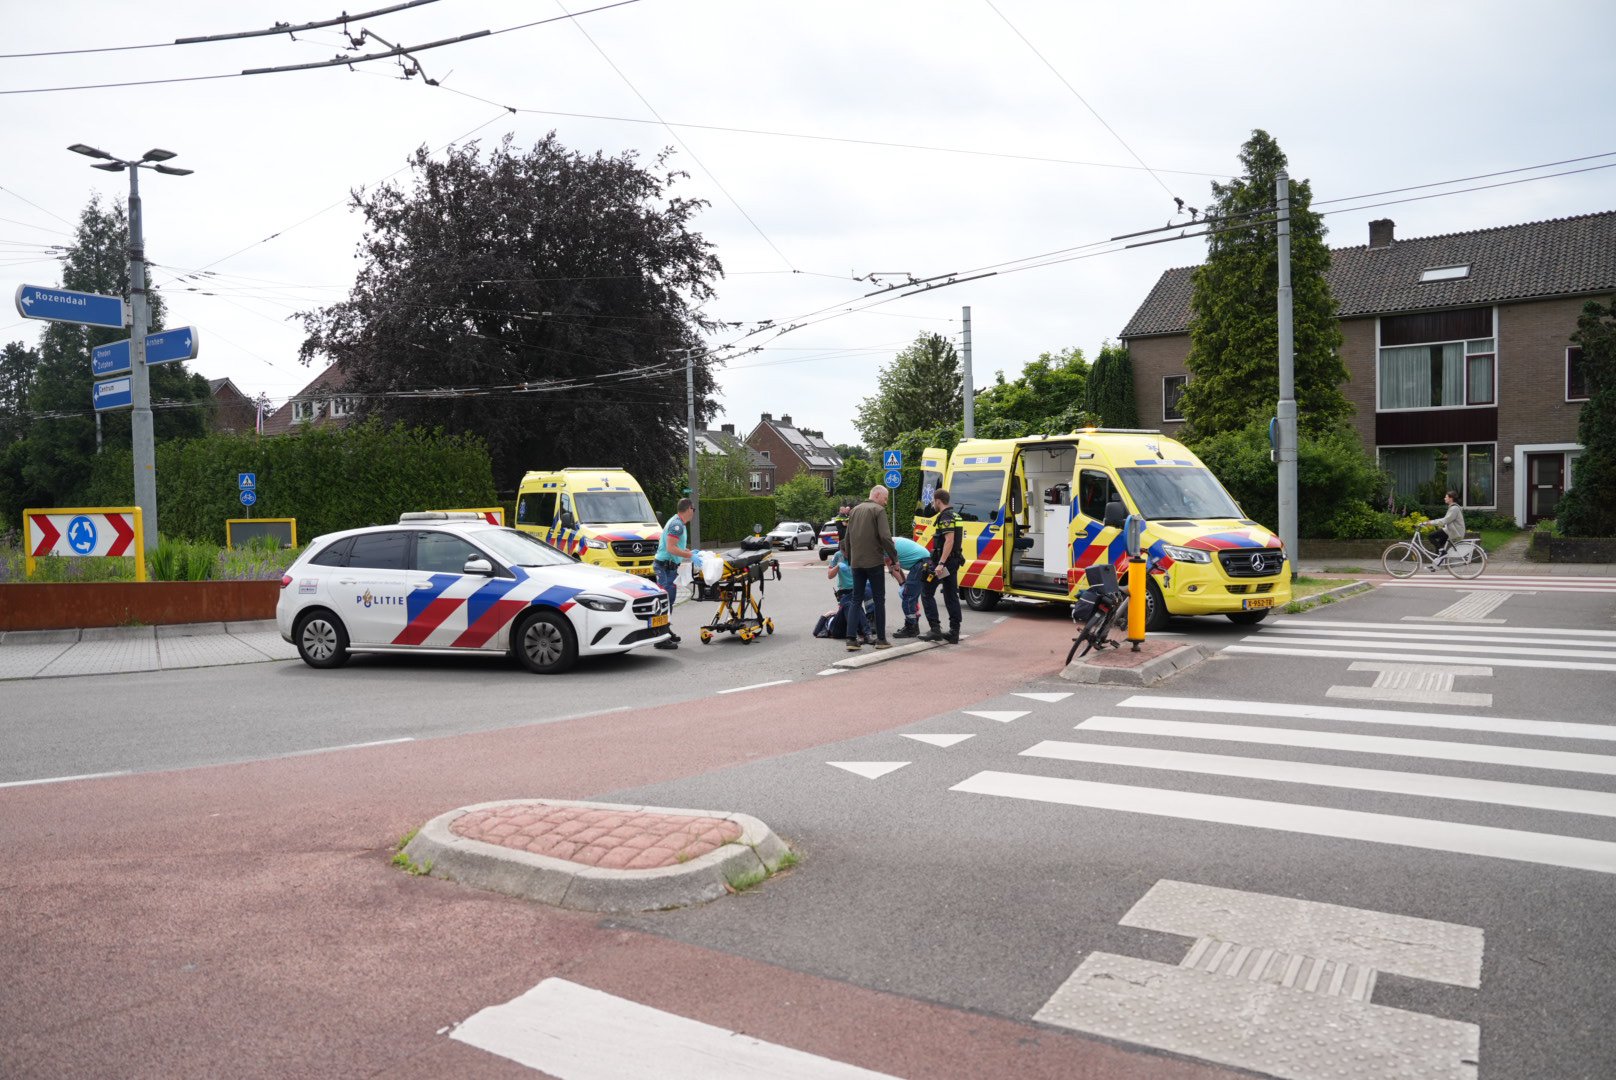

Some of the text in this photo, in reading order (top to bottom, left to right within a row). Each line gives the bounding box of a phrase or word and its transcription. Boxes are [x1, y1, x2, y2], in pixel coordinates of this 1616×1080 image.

[35, 291, 87, 306] Rozendaal
[146, 337, 164, 347] Arnhem
[97, 360, 114, 370] Zutphen
[99, 384, 115, 393] Centrum
[356, 594, 404, 608] POLITIE
